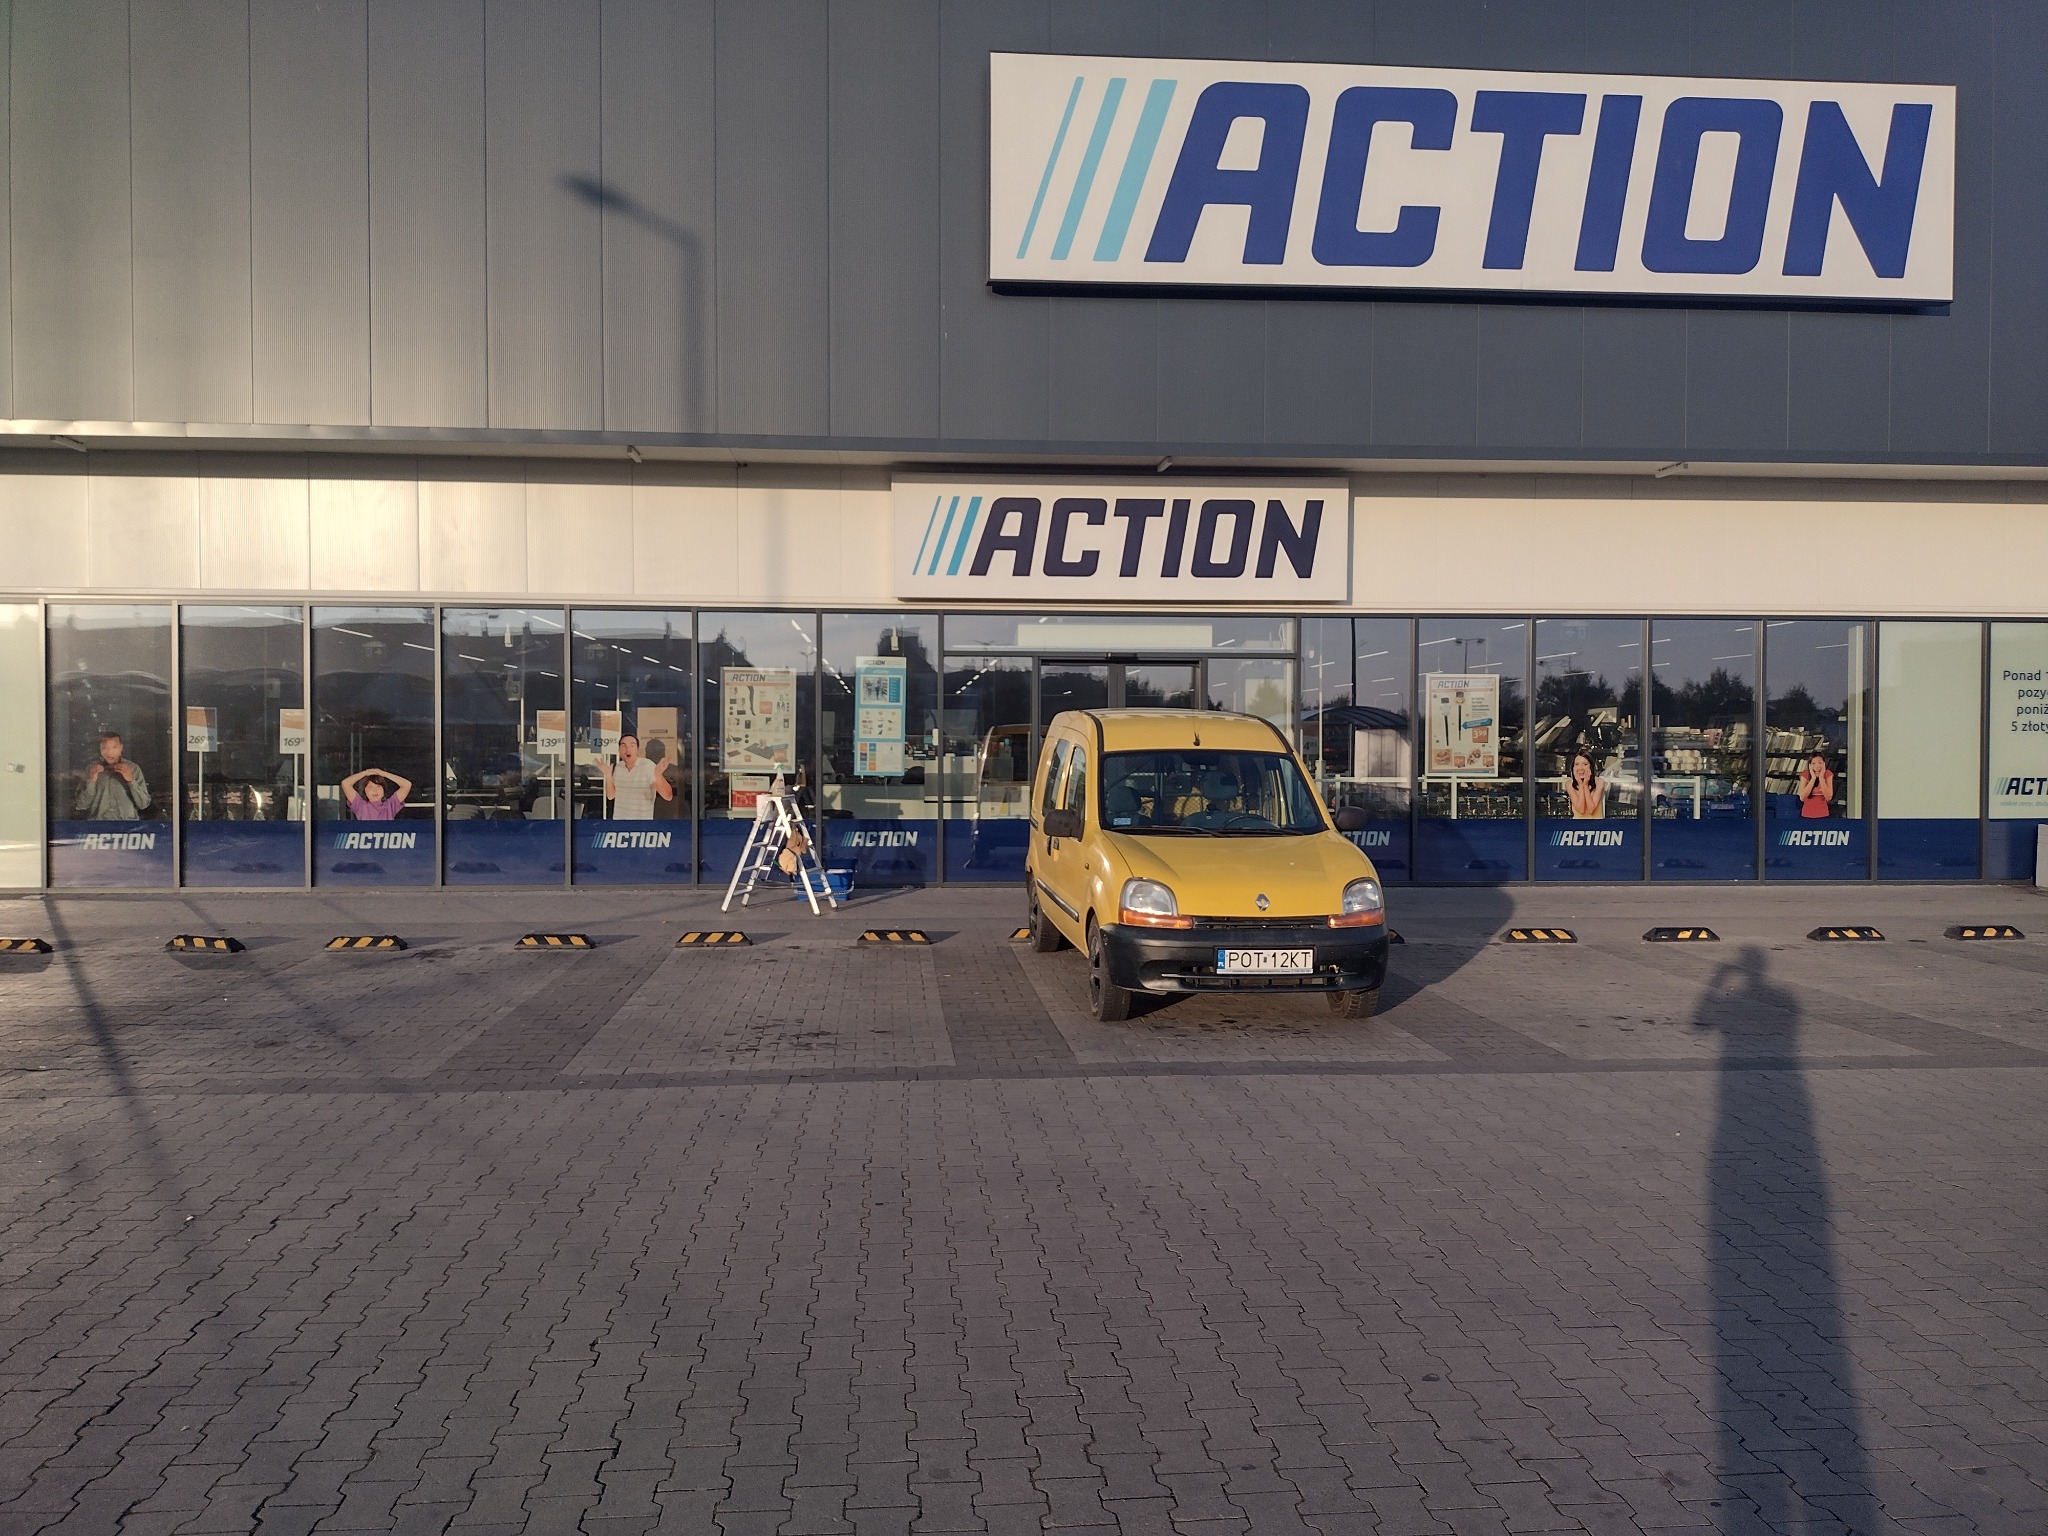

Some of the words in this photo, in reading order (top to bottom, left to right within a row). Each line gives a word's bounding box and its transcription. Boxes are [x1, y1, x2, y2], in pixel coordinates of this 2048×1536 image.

[1143, 81, 1933, 279] ACTION
[969, 497, 1325, 579] ACTION
[732, 673, 766, 682] ACTION
[2003, 670, 2041, 681] Ponad
[1438, 680, 1470, 689] ACTION
[2018, 689, 2048, 700] pozy
[2011, 721, 2018, 732] 5
[83, 833, 156, 850] ACTION
[344, 832, 417, 850] ACTION
[601, 831, 672, 849] ACTION
[850, 831, 919, 848] ACTION
[1341, 830, 1391, 846] CTION
[1558, 830, 1624, 847] ACTION
[1786, 830, 1850, 847] ACTION
[1228, 951, 1264, 968] POT
[1271, 951, 1311, 968] 12KT
